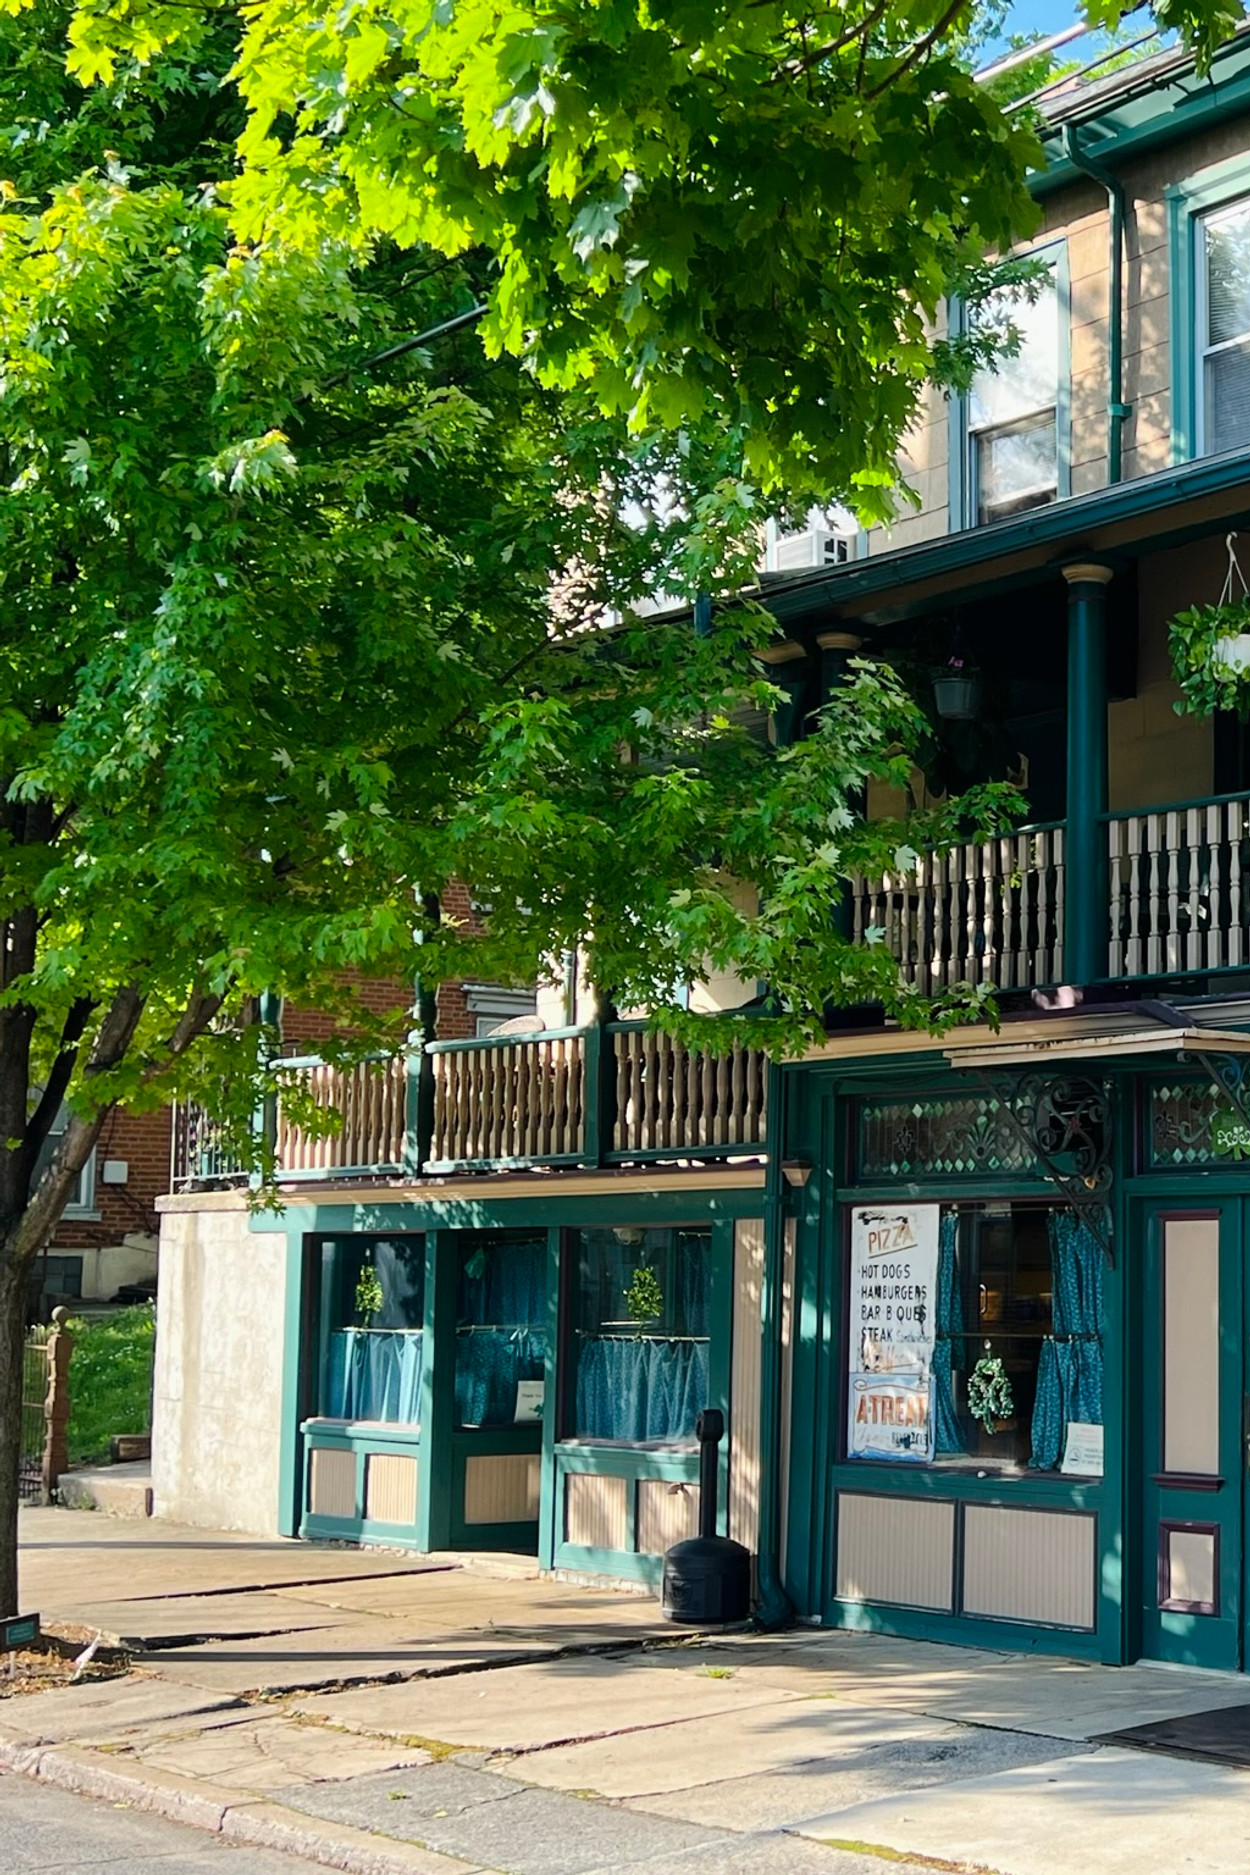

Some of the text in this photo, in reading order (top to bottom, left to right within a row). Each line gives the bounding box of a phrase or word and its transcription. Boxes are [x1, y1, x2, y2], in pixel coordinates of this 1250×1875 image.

[868, 1223, 915, 1254] PIZZA
[861, 1264, 911, 1279] HOT DOGS
[861, 1285, 928, 1300] HAMBURGERS
[861, 1305, 881, 1320] BAR
[886, 1305, 893, 1320] B
[861, 1327, 893, 1343] STEAK
